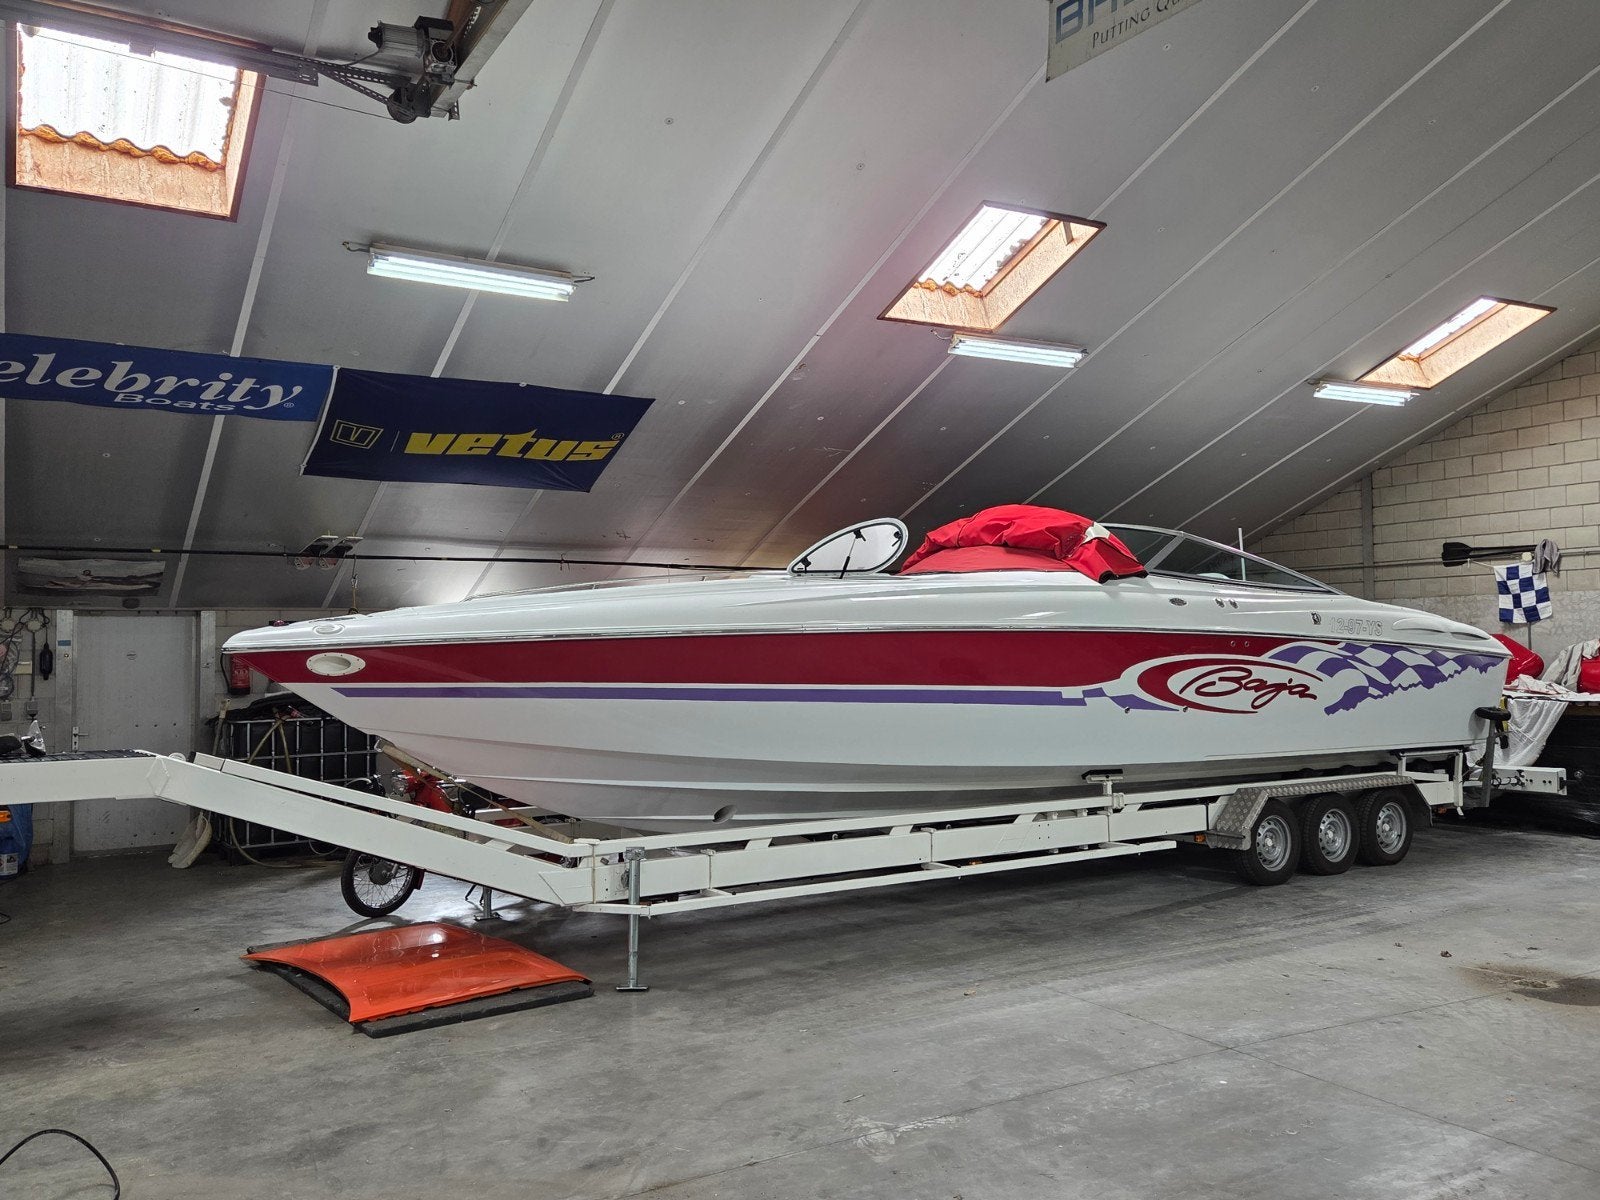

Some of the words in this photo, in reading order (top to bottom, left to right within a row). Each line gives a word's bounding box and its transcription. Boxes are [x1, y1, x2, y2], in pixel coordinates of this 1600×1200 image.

[1092, 7, 1150, 48] PUTTING
[114, 393, 235, 411] Boats
[404, 429, 620, 461] vetus
[1330, 617, 1383, 636] 12-97-YS
[1179, 666, 1317, 709] Baja
